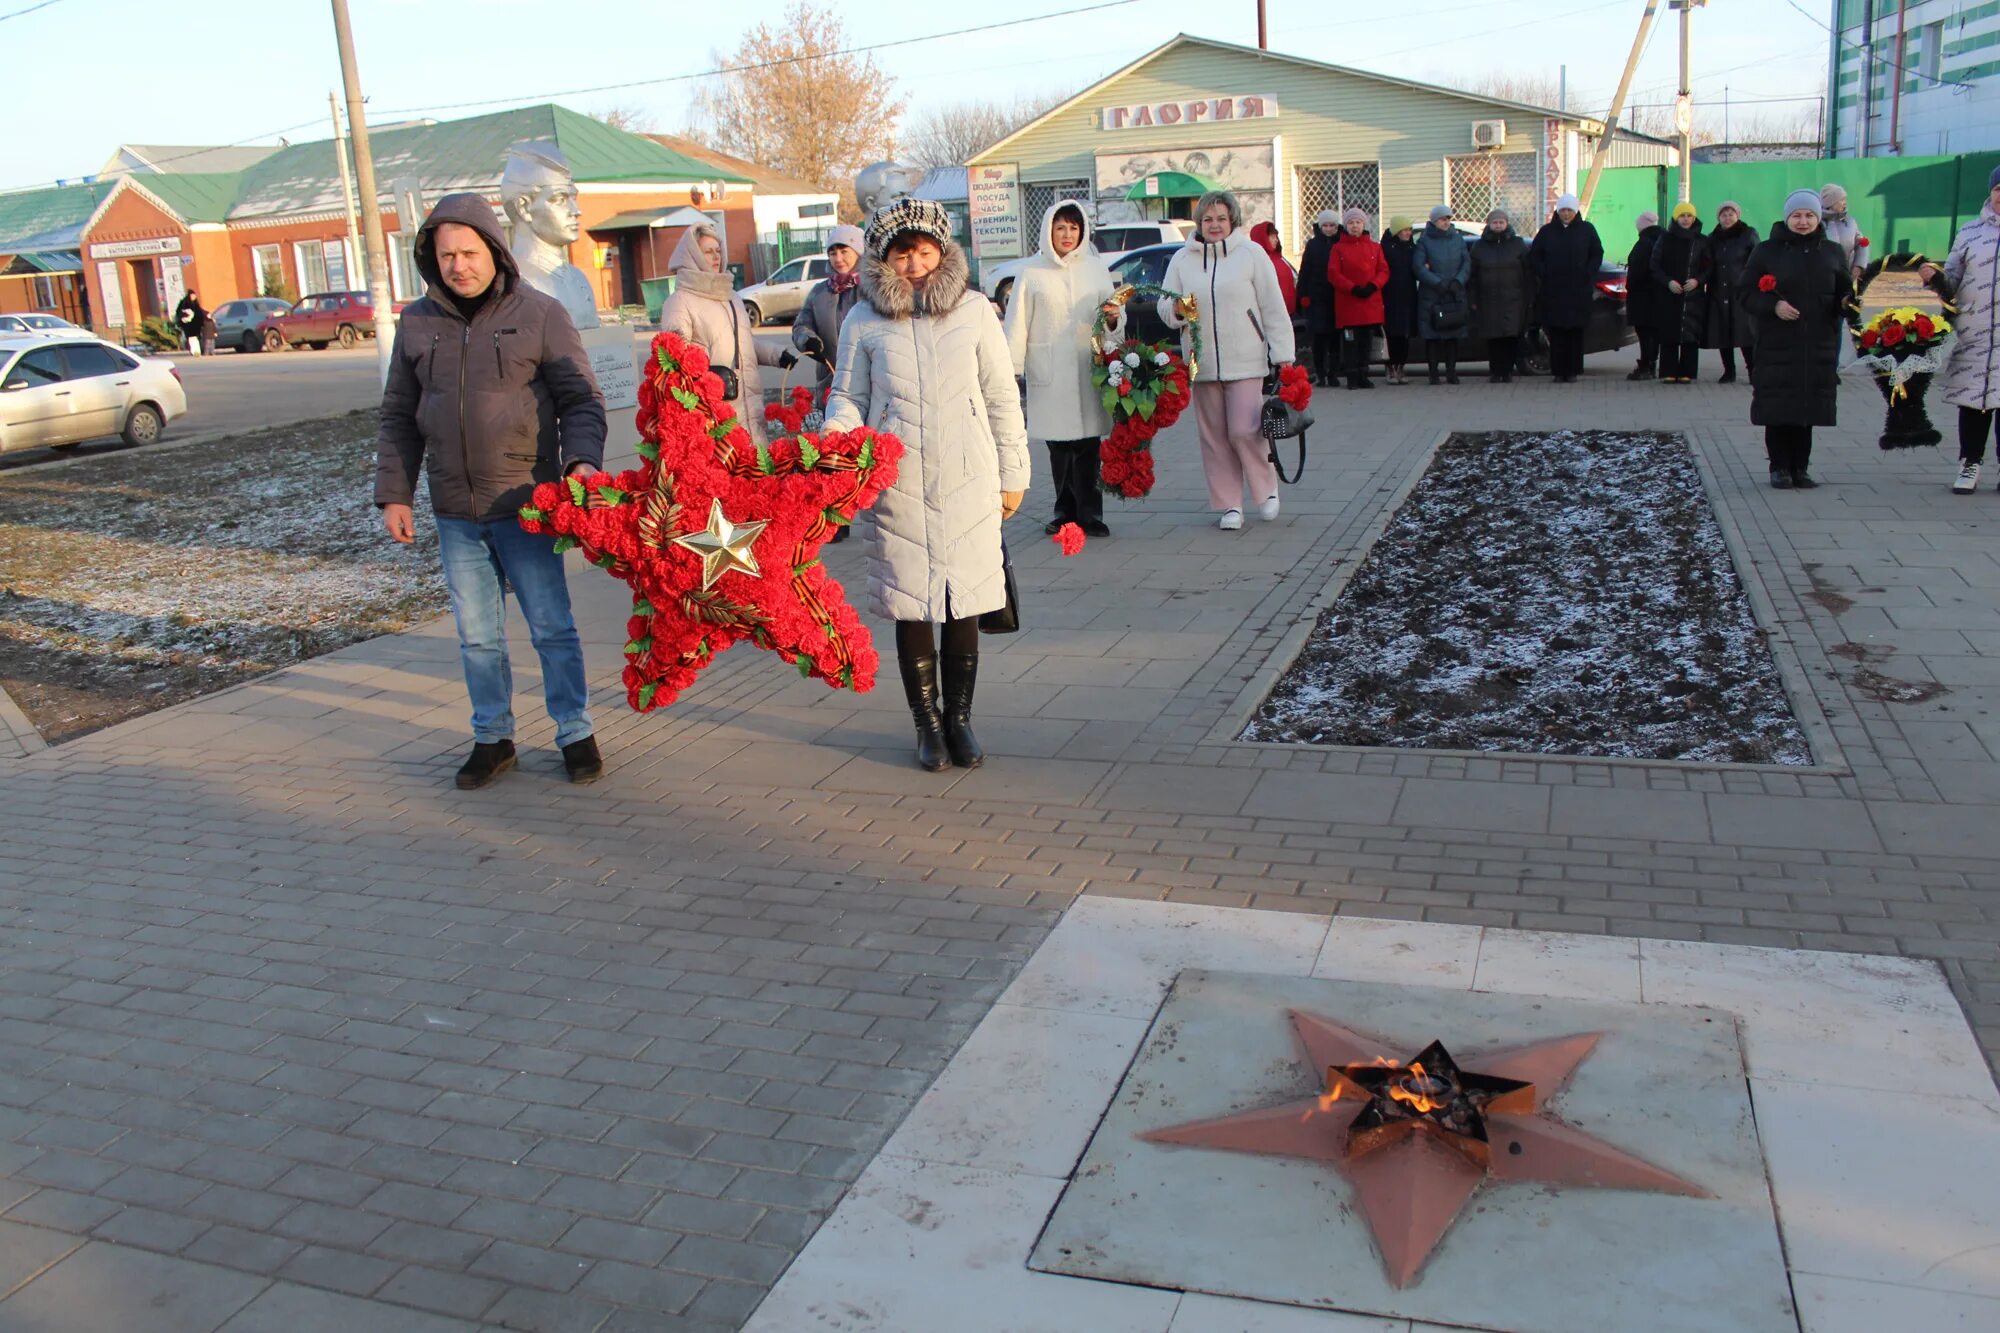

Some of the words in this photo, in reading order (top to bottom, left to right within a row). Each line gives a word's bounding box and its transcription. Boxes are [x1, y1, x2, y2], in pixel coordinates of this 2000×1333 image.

[1112, 97, 1264, 128] ГЛОРИЯ
[972, 181, 1015, 191] ПОДАРКОВ
[976, 193, 1011, 202] ПОСУДА
[980, 205, 1005, 213] ЧАСЫ
[973, 215, 1018, 225] СУВЕНИРЫ
[975, 226, 1018, 236] ТЕКСТИЛЬ
